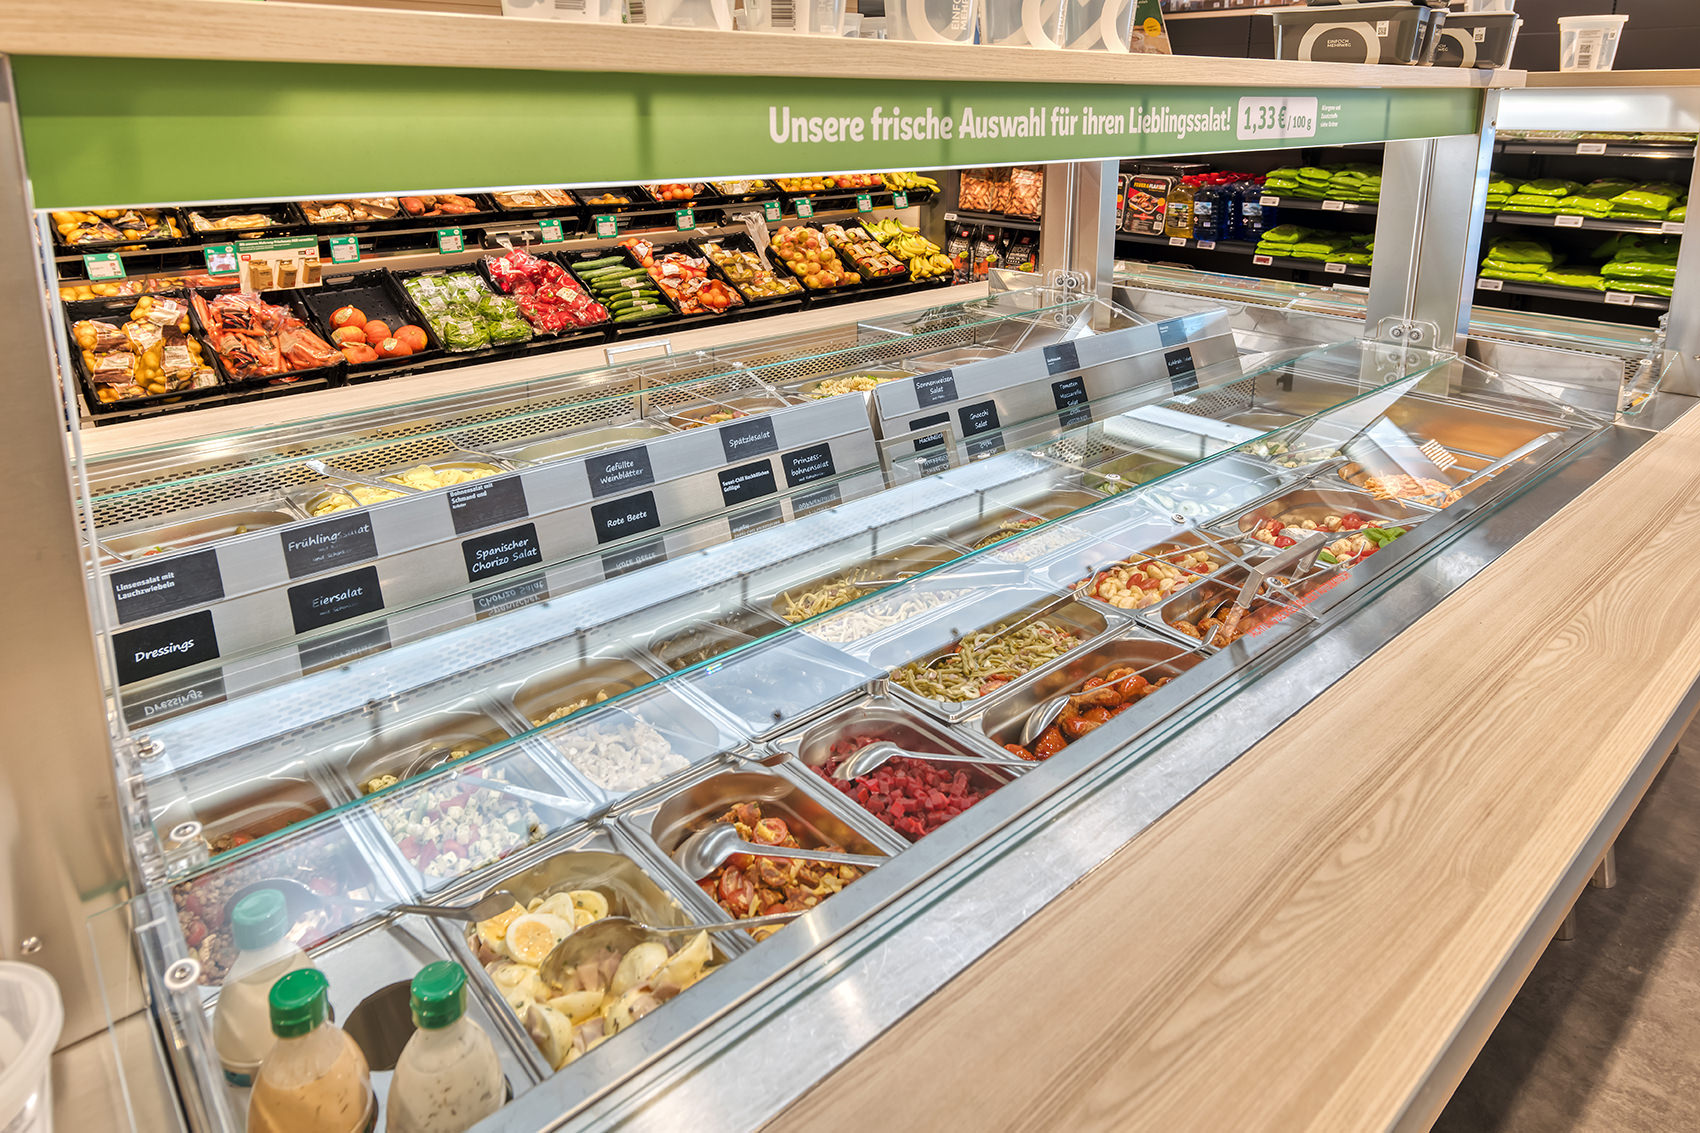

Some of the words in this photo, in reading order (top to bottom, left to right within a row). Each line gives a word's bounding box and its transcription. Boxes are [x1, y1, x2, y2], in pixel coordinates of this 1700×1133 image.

[769, 106, 864, 144] Unsere
[871, 106, 953, 141] frische
[959, 106, 1046, 139] Auswahl
[1051, 106, 1079, 136] für
[1082, 108, 1125, 135] ihren
[1129, 106, 1231, 139] Lieblingssalat!
[930, 386, 944, 395] Salat
[975, 421, 988, 429] Salat
[729, 431, 770, 448] Spätzlesalat
[605, 460, 634, 473] Gefüllte
[793, 453, 822, 465] Prinzess-
[600, 468, 644, 484] Weinblätter
[791, 461, 829, 476] bohnensalat
[451, 493, 476, 504] Schmand
[477, 490, 487, 498] und
[607, 518, 625, 528] Rote
[626, 511, 647, 523] Beete
[475, 538, 529, 560] Spanischer
[472, 557, 509, 573] Chorizo
[513, 547, 538, 562] Salat
[116, 574, 160, 592] Linsensalat
[161, 571, 175, 582] mit
[117, 581, 175, 601] Lauchzwiebeln
[312, 586, 363, 608] Eiersalat
[134, 639, 195, 663] Dressings
